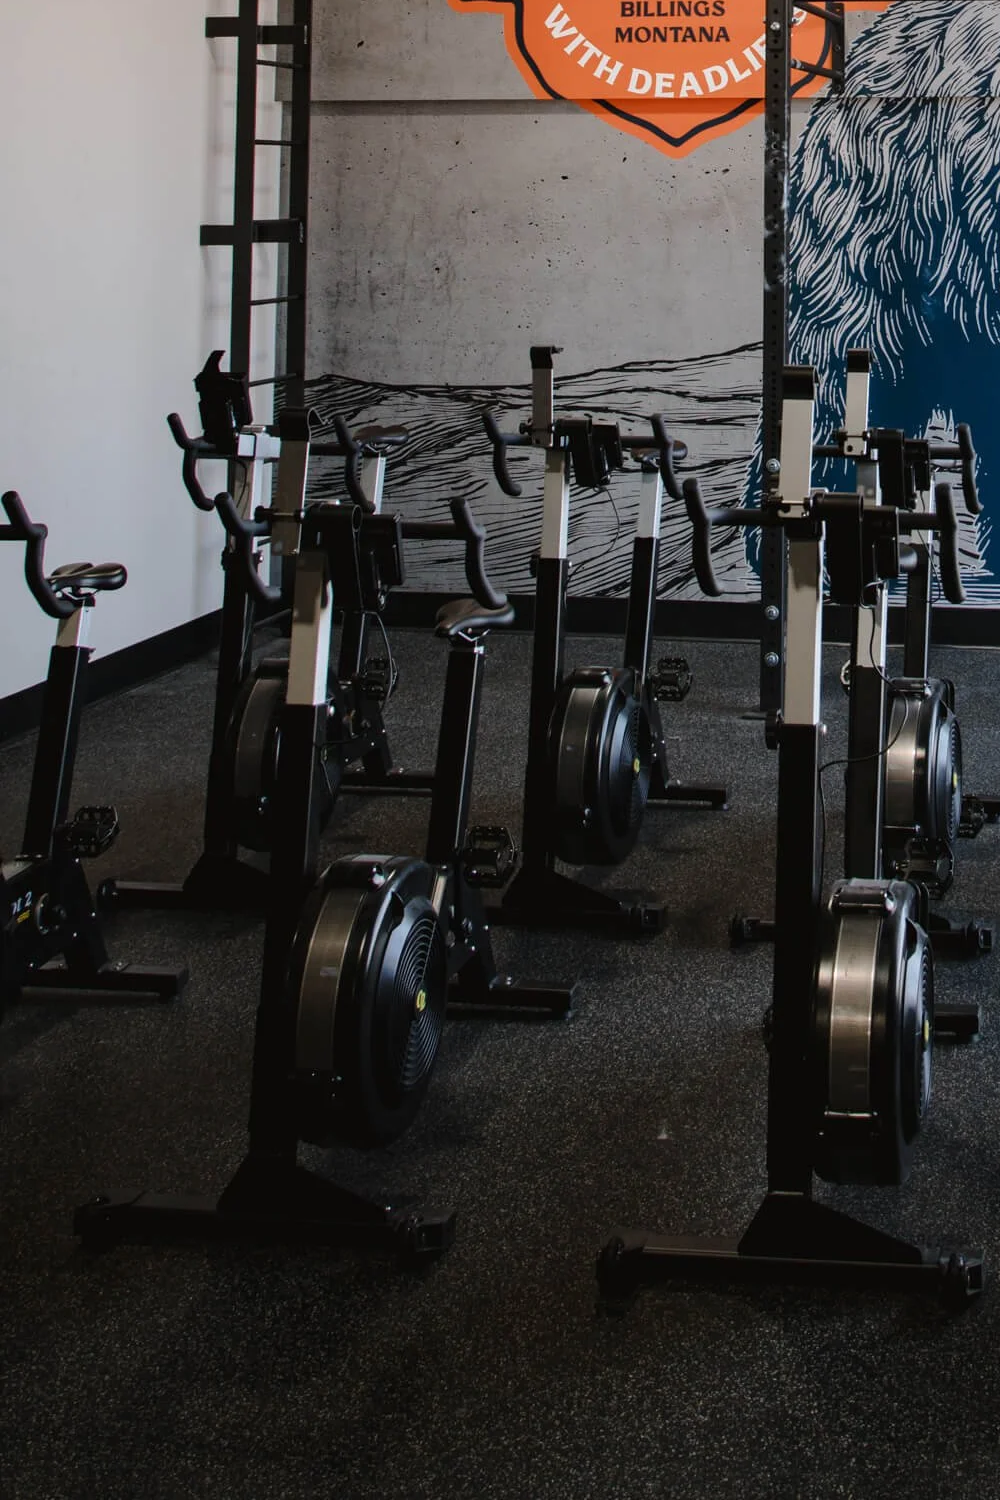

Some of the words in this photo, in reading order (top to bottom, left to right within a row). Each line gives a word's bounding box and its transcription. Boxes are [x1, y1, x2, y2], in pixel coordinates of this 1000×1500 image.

[620, 0, 726, 18] BILLINGS
[615, 26, 731, 43] MONTANA
[544, 3, 625, 86] WITH
